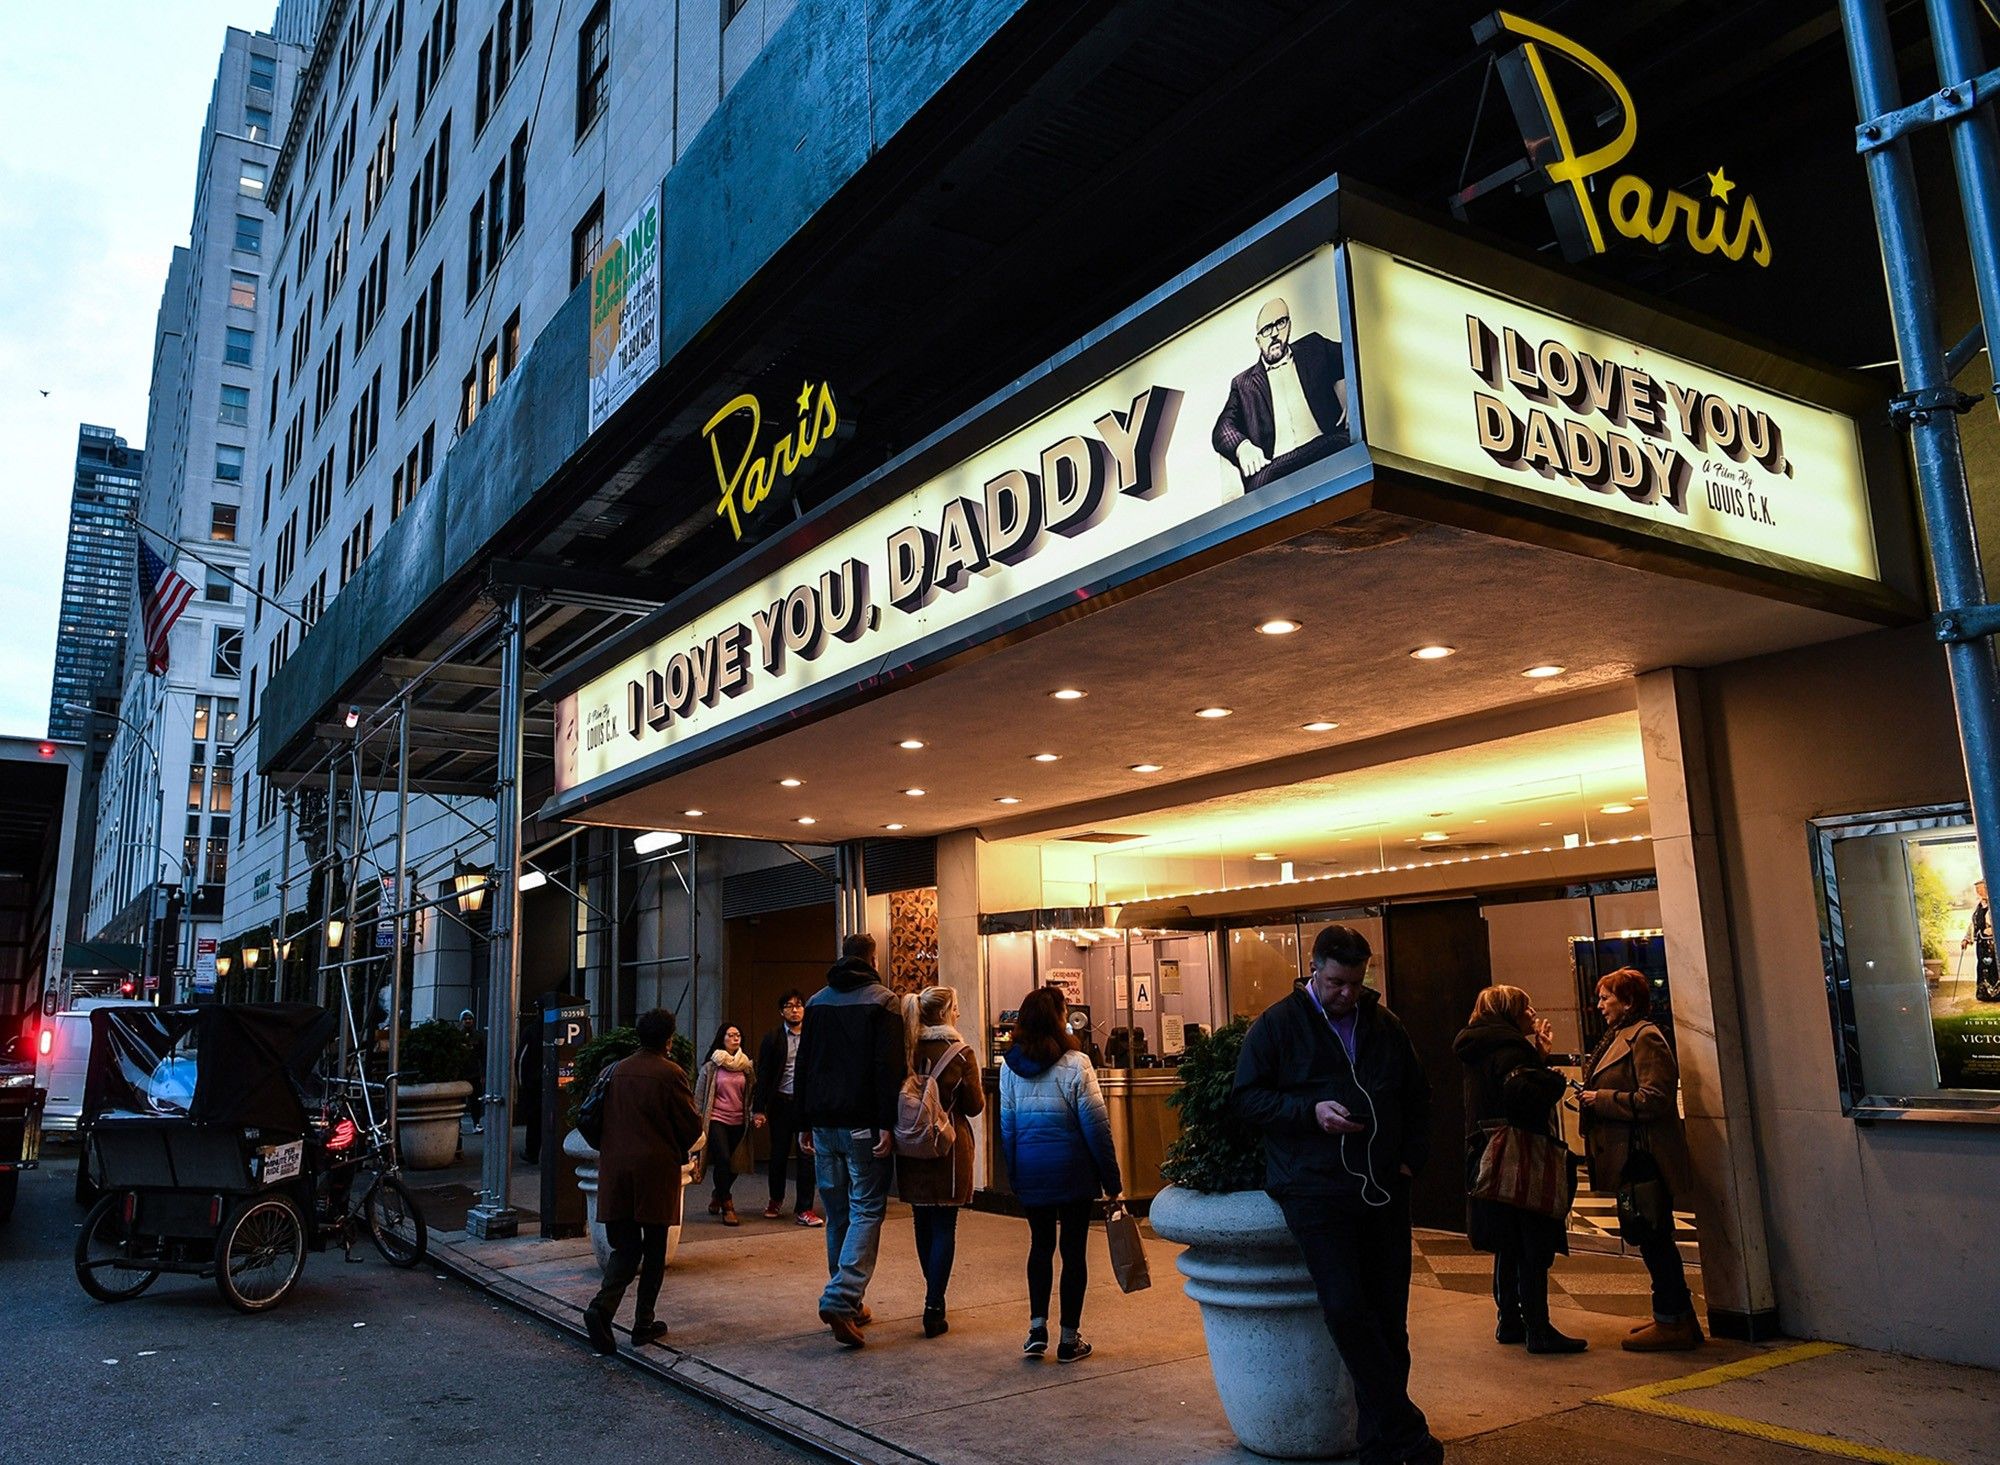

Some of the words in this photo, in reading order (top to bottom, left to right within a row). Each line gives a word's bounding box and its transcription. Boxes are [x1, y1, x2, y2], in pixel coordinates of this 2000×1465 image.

[1498, 10, 1773, 268] Paris
[595, 206, 657, 310] SPRING
[1466, 313, 1503, 391] I
[1503, 326, 1672, 442] LOVE
[1665, 380, 1794, 480] YOU,
[1474, 391, 1693, 515] DADDY
[702, 379, 837, 542] Paris
[1702, 459, 1711, 473] A
[1713, 462, 1736, 481] Film
[1738, 469, 1753, 490] By
[1706, 480, 1745, 518] LOUIS
[1748, 492, 1776, 526] C.K.
[628, 679, 645, 741] I
[647, 622, 755, 732] LOVE
[753, 558, 882, 678] YOU,
[887, 385, 1186, 615] DADDY
[567, 1023, 581, 1045] P
[1137, 983, 1149, 1003] A
